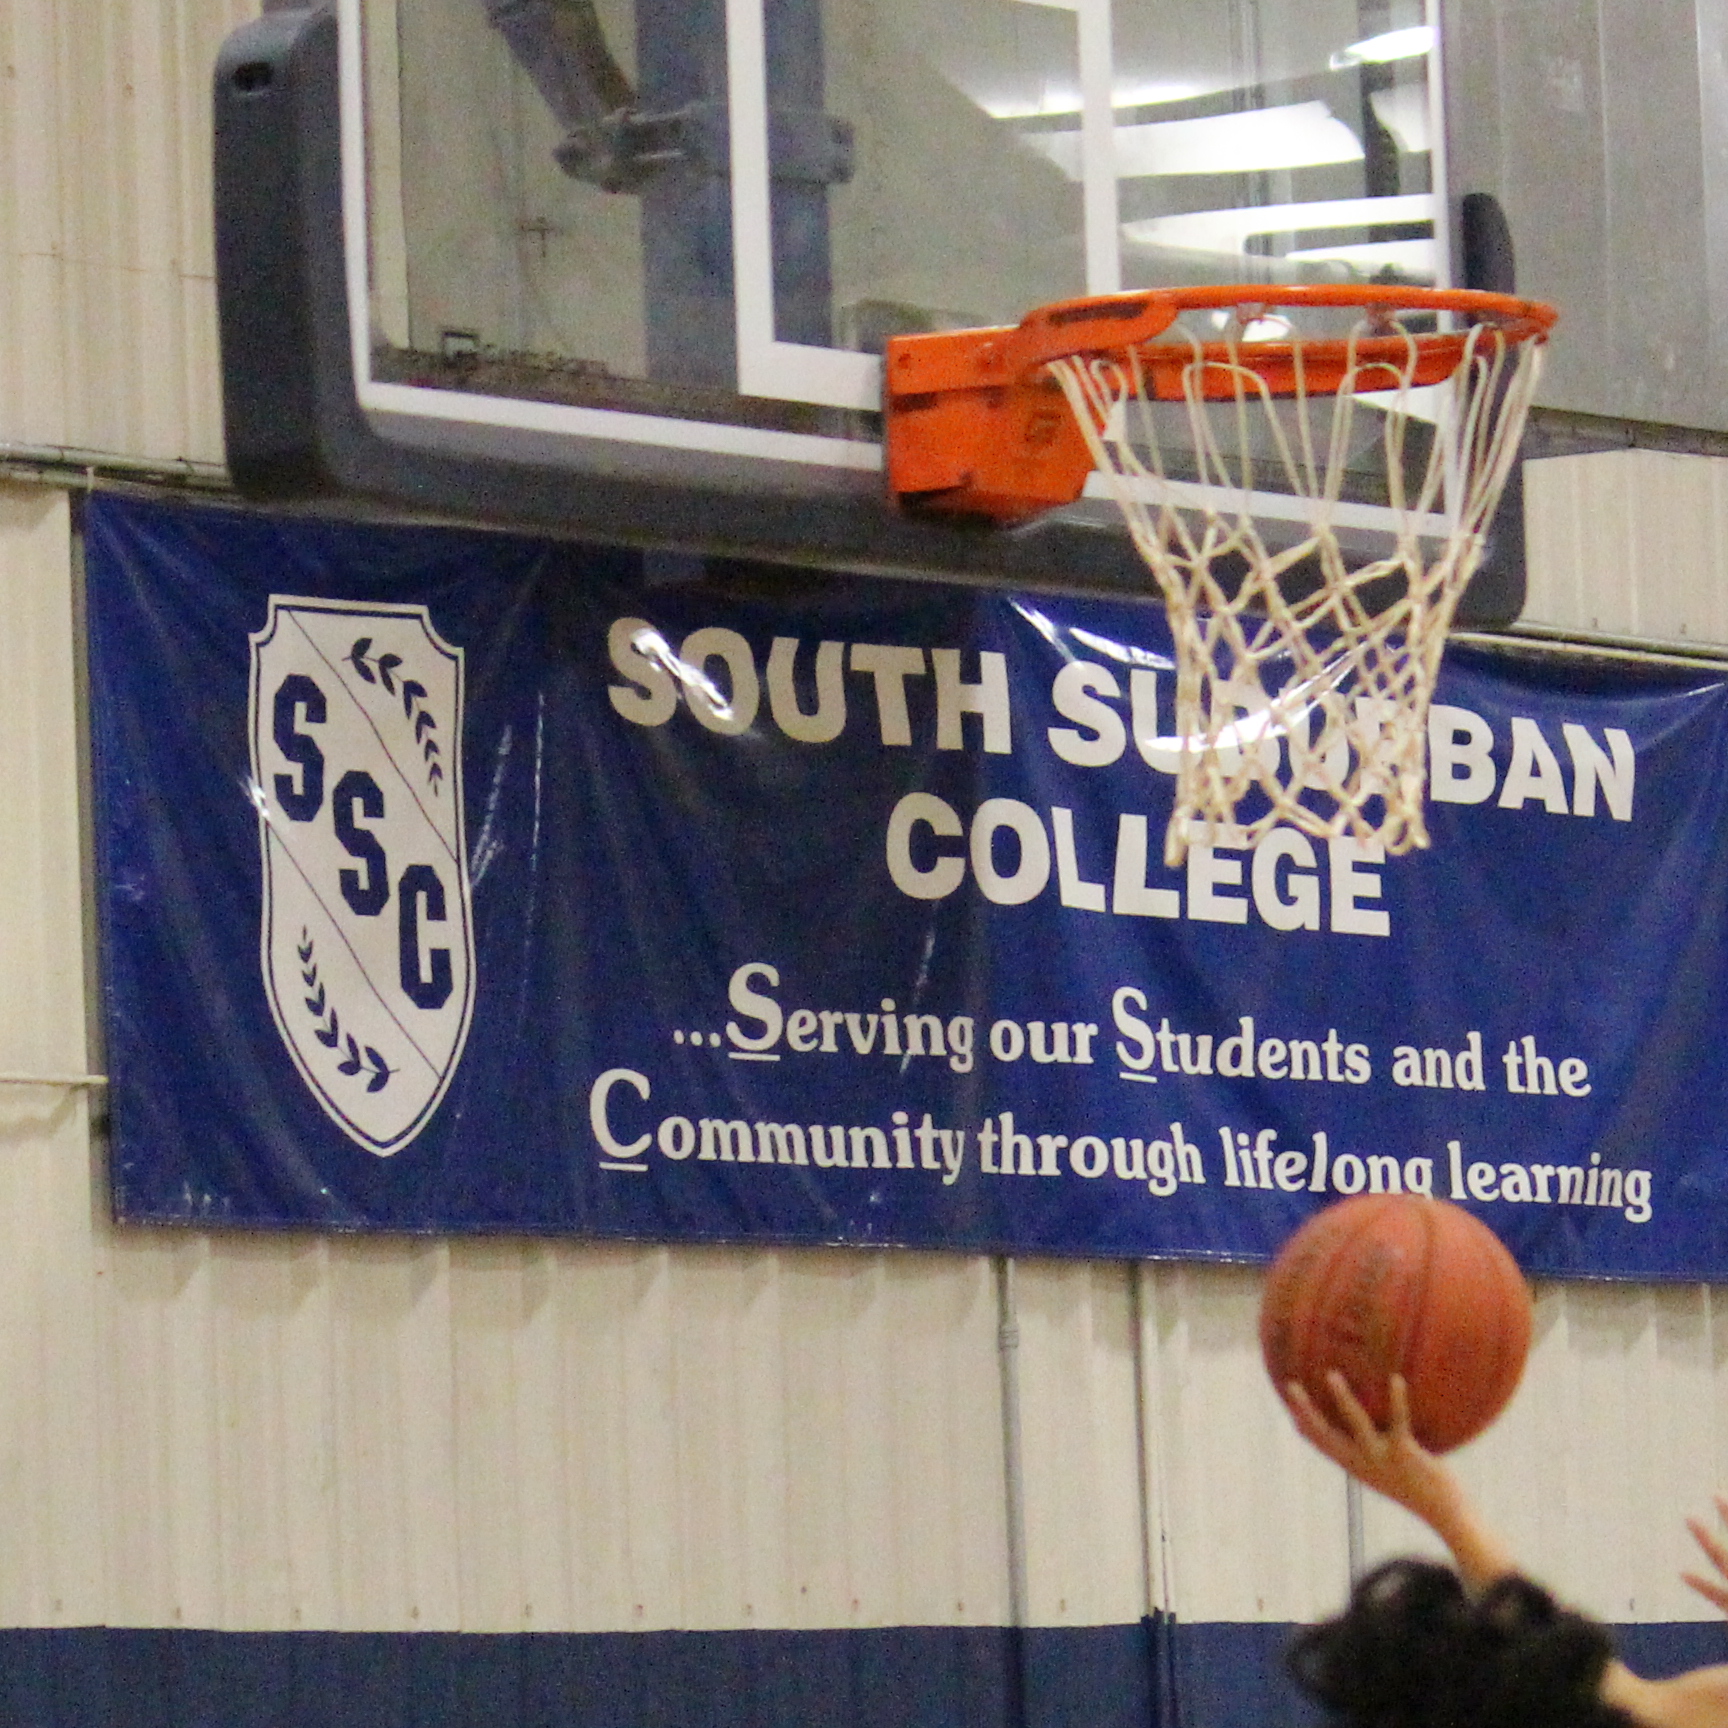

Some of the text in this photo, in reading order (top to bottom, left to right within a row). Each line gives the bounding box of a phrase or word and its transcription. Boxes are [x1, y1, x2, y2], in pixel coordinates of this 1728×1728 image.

[608, 617, 1013, 755] SOUTH
[886, 792, 1391, 937] COLLEGE
[990, 1018, 1098, 1065] our
[1112, 986, 1372, 1084] Students
[1392, 1032, 1485, 1091] and
[1503, 1036, 1591, 1097] the
[589, 1068, 1653, 1222] Community through lifelong learning
